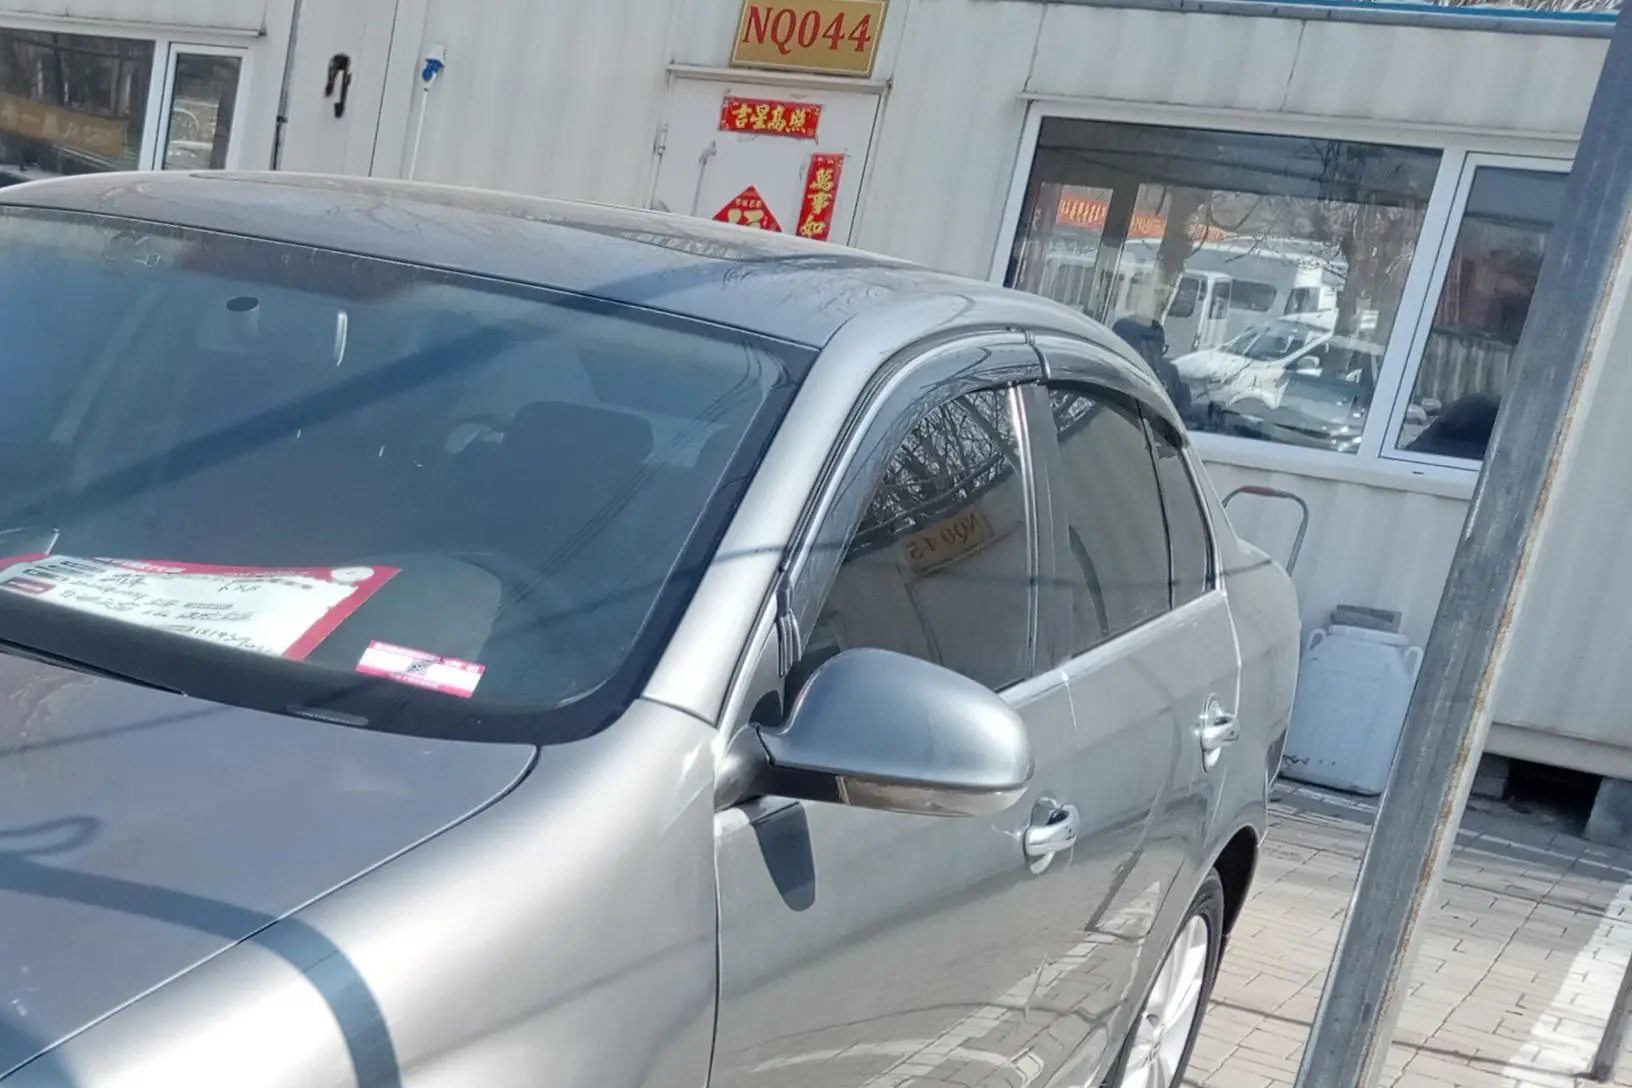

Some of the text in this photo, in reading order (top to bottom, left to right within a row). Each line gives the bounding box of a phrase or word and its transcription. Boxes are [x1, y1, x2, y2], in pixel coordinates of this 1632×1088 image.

[743, 6, 872, 55] NQ044
[732, 103, 807, 134] 吉星高照
